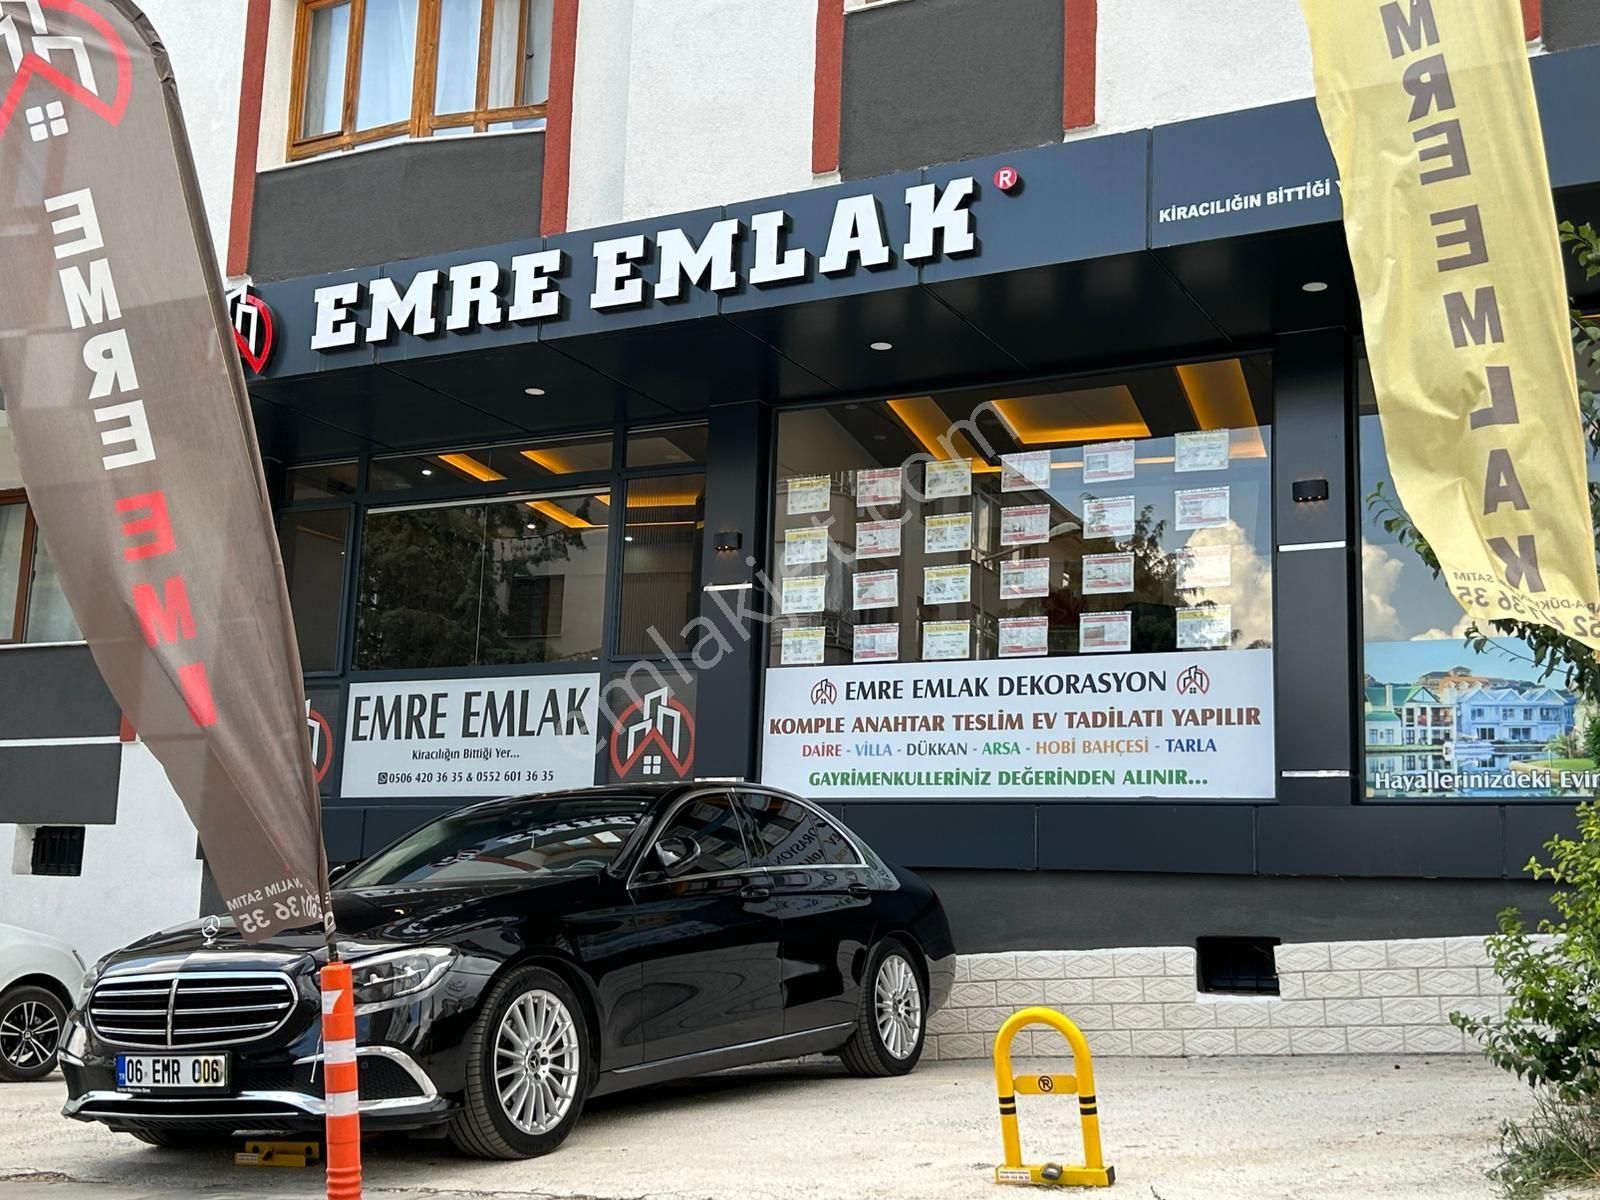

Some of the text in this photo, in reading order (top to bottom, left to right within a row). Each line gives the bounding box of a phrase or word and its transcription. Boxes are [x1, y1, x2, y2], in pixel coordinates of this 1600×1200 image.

[1158, 194, 1261, 223] KİRACILIĞIN
[1266, 178, 1331, 206] BİTTİĞİ
[310, 176, 977, 352] EMRE EMLAK
[845, 671, 1167, 701] EMRE EMLAK DEKORASYON
[351, 687, 591, 742] EMRE EMLAK
[769, 706, 1261, 735] KOMPLE ANAHTAR TESLİM EV TADİLATI YAPILIR
[412, 747, 520, 761] Kiracılığın Bittiği Yer...
[802, 741, 843, 758] DAİRE
[855, 740, 893, 757] VİLLA
[906, 740, 968, 757] DÜKKAN
[982, 741, 1021, 756] ARSA
[1035, 738, 1076, 755] HOBİ
[1082, 736, 1149, 757] BAHÇESİ
[1165, 738, 1217, 753] TARLA
[389, 770, 554, 783] 0506 420 36 35 & 0552 601 36 35
[808, 766, 1208, 786] GAYRİMENKULLERİNİZ DEĞERİNDEN ALINIR...
[1375, 770, 1551, 791] Hayallerinizdeki
[126, 1058, 143, 1083] 06
[152, 1058, 181, 1084] EMR
[192, 1058, 219, 1083] 006
